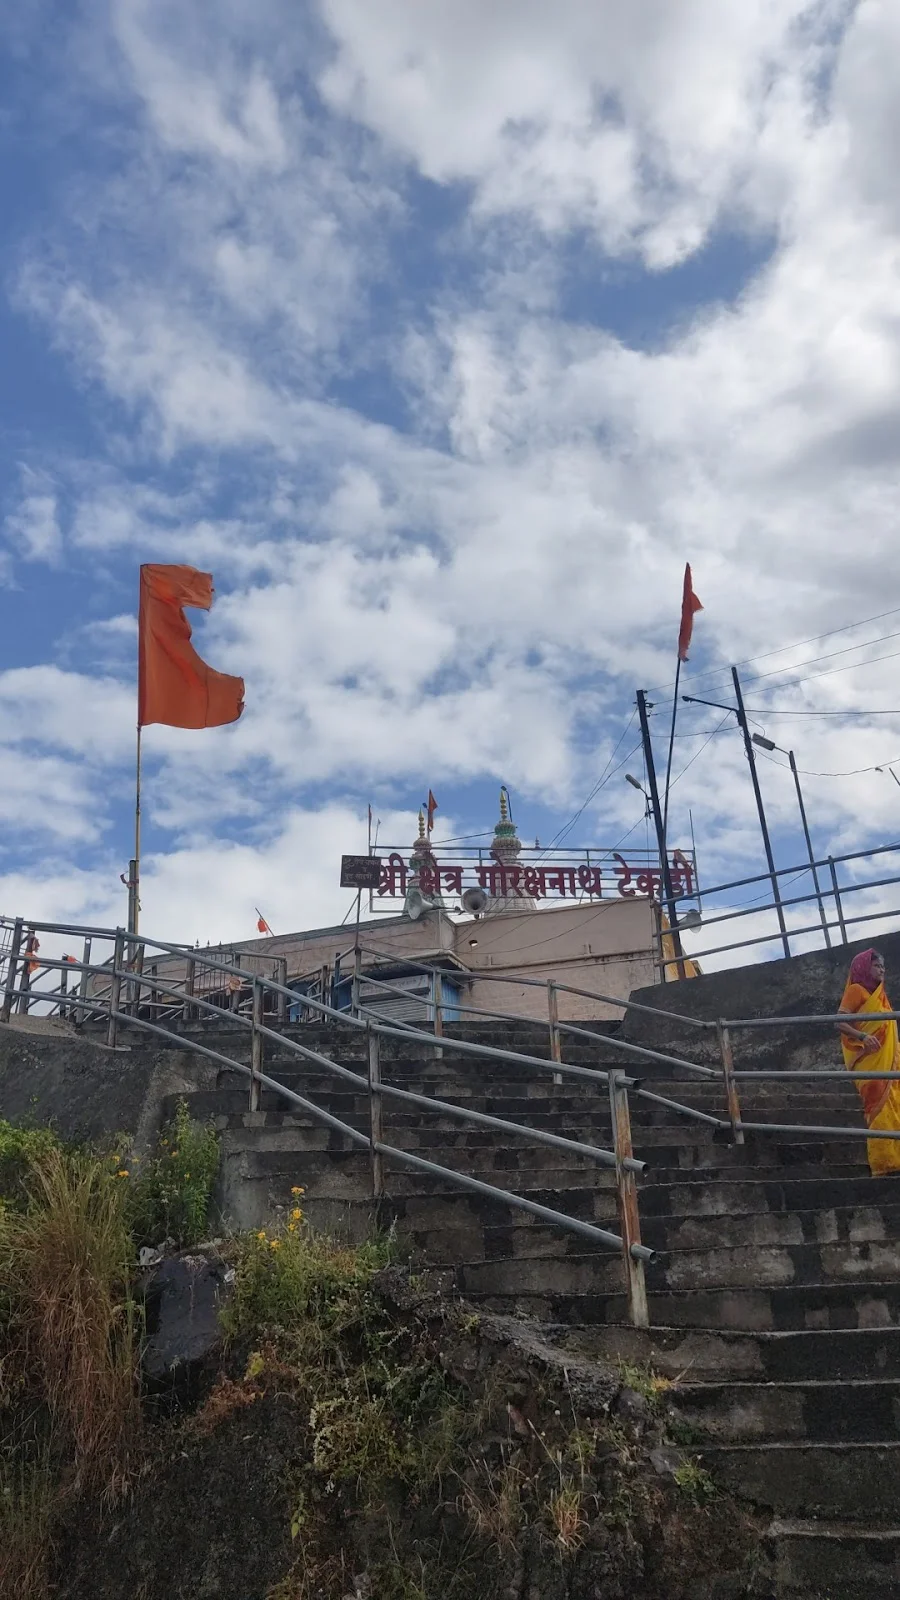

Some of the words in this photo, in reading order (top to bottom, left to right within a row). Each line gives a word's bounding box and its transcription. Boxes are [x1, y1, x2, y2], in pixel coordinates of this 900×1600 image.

[377, 853, 409, 897] श्री
[419, 851, 464, 899] क्षेत्र
[474, 851, 602, 900] गोरक्षनाथ
